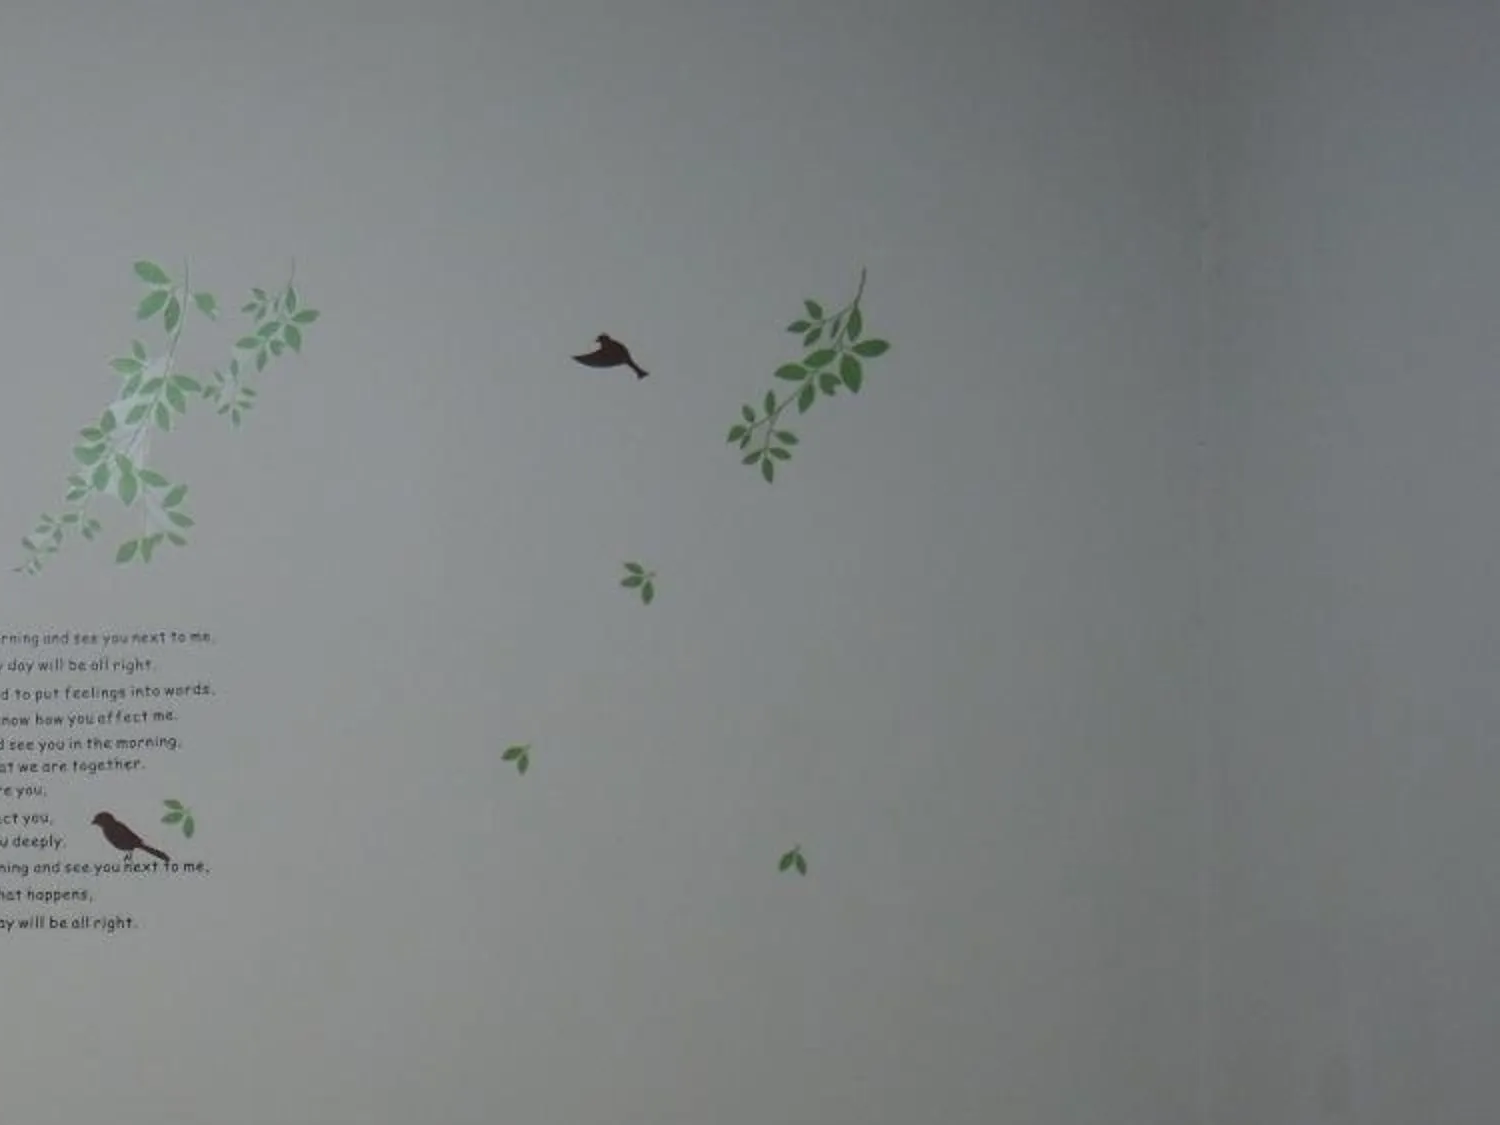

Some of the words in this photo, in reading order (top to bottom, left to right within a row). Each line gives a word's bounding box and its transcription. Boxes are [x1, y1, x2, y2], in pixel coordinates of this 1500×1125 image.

[43, 632, 70, 644] and
[74, 634, 98, 645] see
[103, 634, 128, 647] you
[132, 632, 166, 644] next
[171, 632, 186, 643] to
[8, 659, 35, 675] day
[38, 658, 64, 672] will
[68, 660, 87, 671] be
[91, 658, 109, 671] all
[15, 689, 31, 701] to
[35, 689, 59, 703] put
[65, 686, 126, 702] feelings
[131, 686, 161, 697] into
[35, 713, 64, 726] how
[67, 714, 94, 727] you
[98, 711, 149, 725] affect
[9, 740, 34, 751] see
[38, 740, 65, 752] you
[69, 738, 82, 750] in
[87, 737, 113, 750] the
[19, 762, 39, 773] we
[42, 762, 68, 773] are
[34, 861, 61, 873] and
[65, 863, 90, 873] see
[94, 863, 121, 876] you
[124, 862, 159, 873] next
[18, 916, 45, 929] will
[49, 916, 68, 929] be
[71, 915, 90, 928] all
